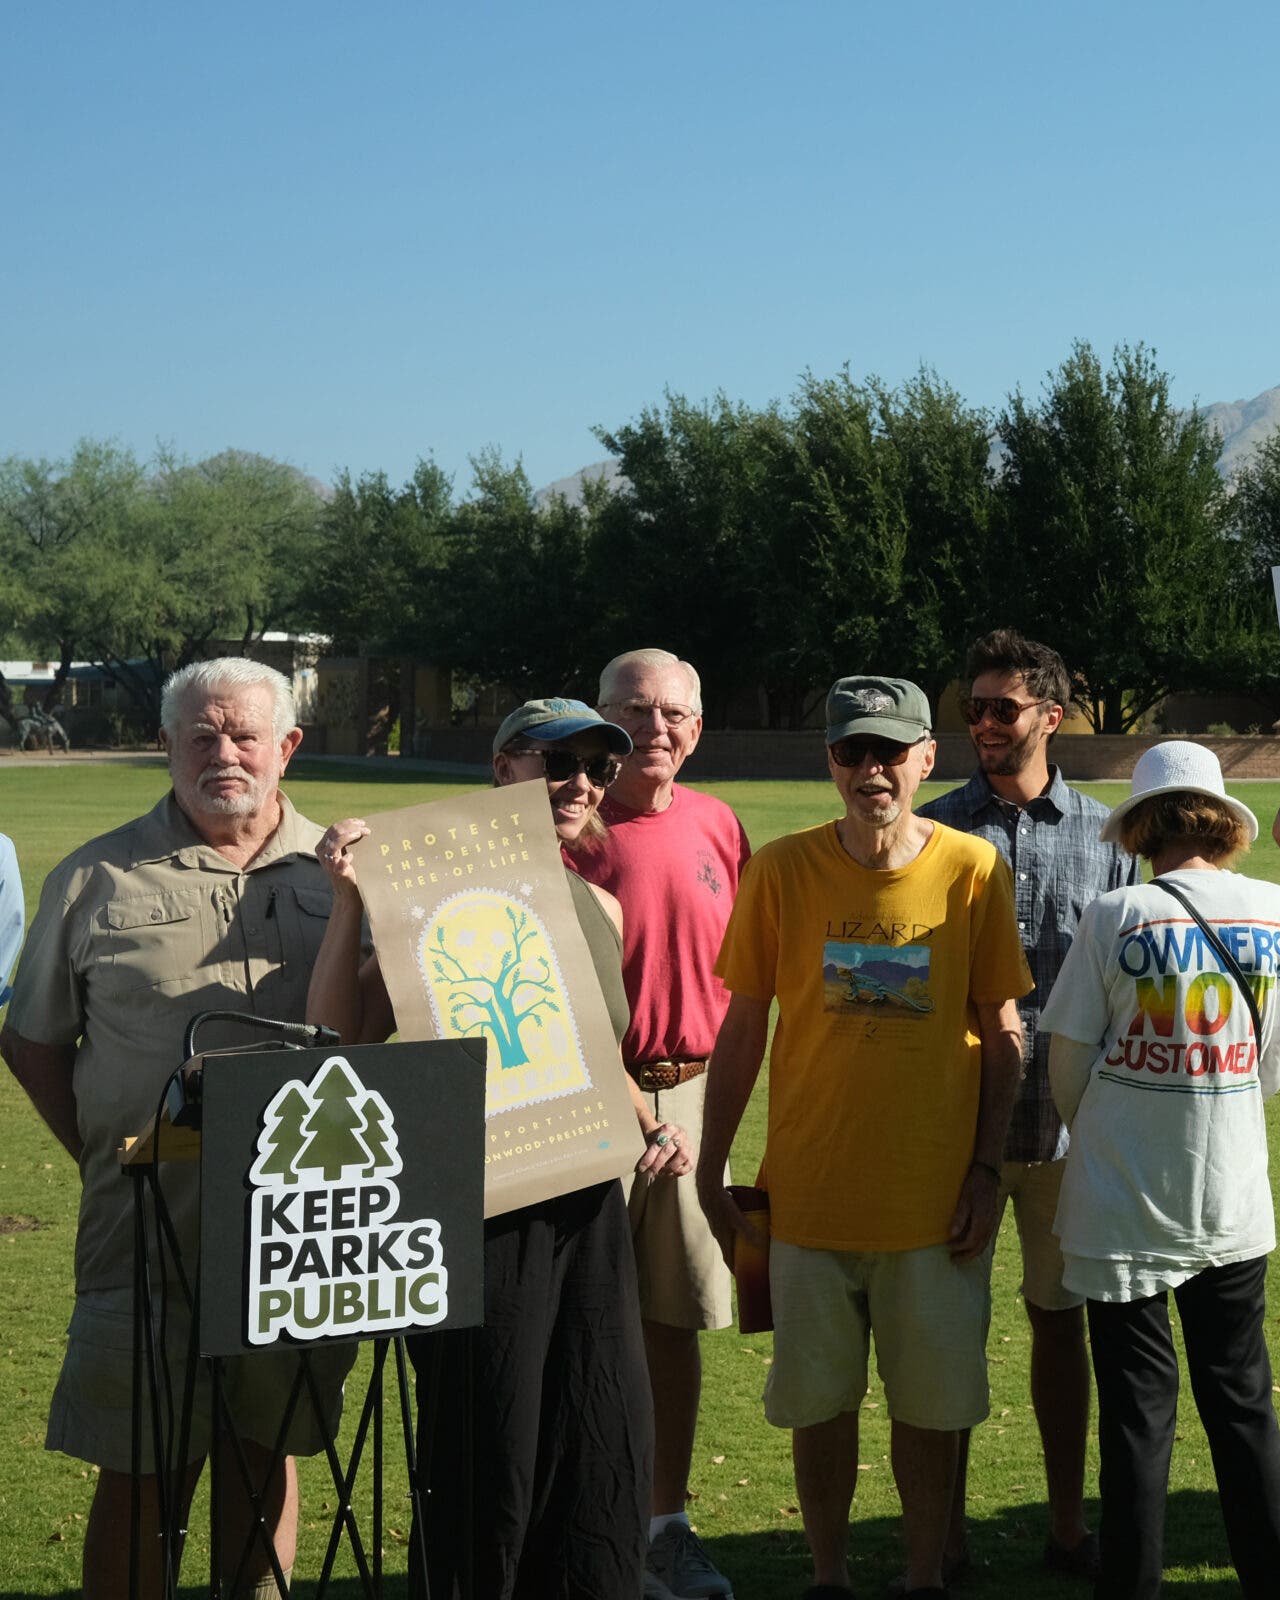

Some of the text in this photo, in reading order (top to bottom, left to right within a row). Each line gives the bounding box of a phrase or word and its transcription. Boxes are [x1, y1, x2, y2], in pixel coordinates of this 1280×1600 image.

[380, 813, 520, 857] PROTECT
[385, 833, 524, 874] THE DESERT
[391, 850, 530, 891] TREE OF LIFE
[826, 921, 934, 941] LIZARD
[485, 1119, 610, 1164] ONWOOD PRESERVE
[490, 1101, 606, 1143] PPORT THE
[261, 1185, 391, 1237] KEEP
[260, 1226, 435, 1285] PARKS
[258, 1272, 439, 1333] PUBLIC
